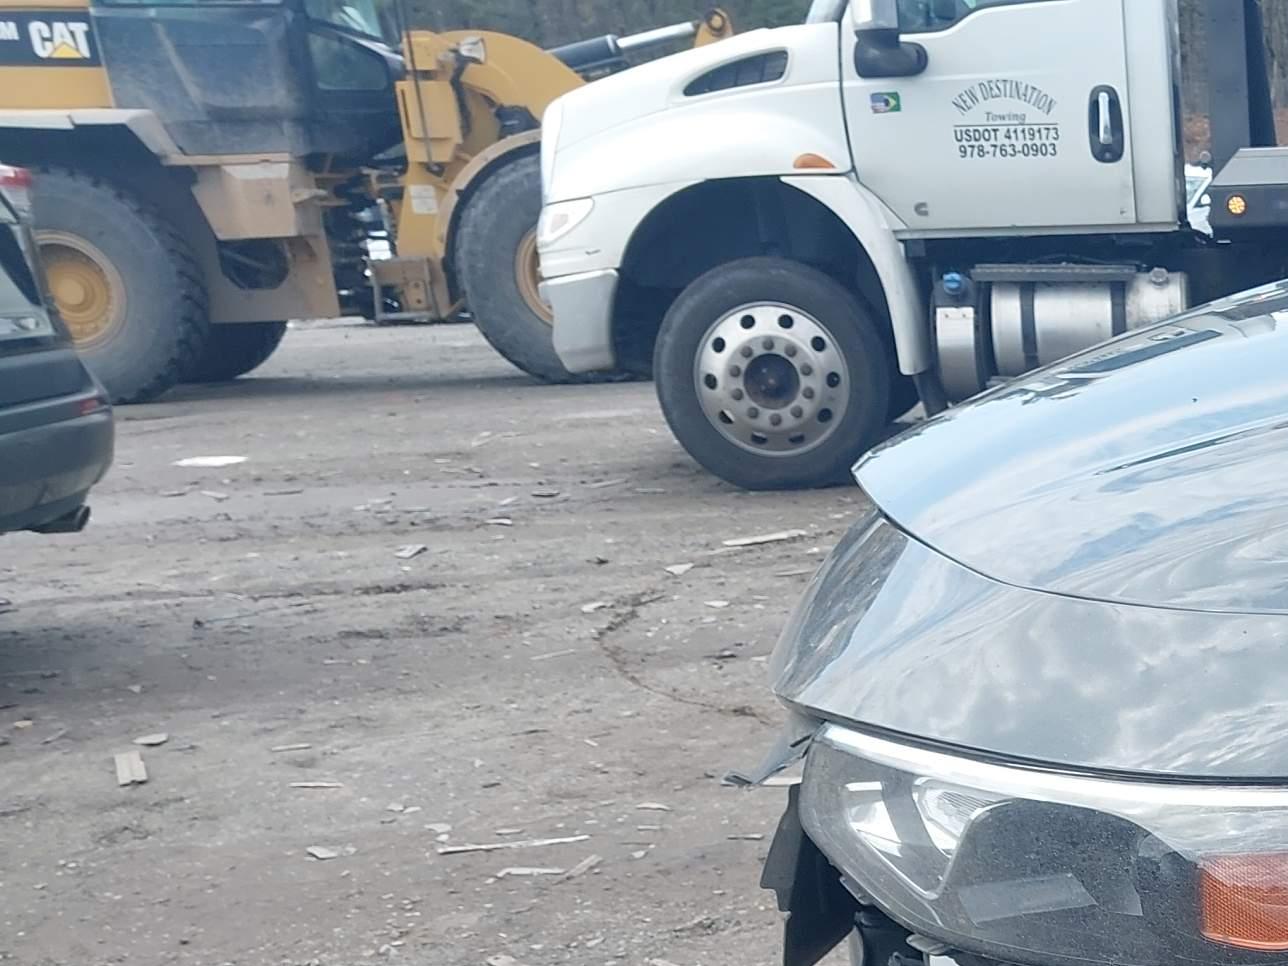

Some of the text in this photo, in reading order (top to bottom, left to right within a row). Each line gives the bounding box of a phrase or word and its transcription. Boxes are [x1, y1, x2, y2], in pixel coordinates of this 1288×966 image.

[28, 21, 91, 58] CAT
[952, 79, 1058, 116] NEW DESTINATION
[984, 111, 1026, 125] Towing
[954, 127, 1060, 142] USDOT 4119173
[959, 143, 1057, 158] 978-763-0903
